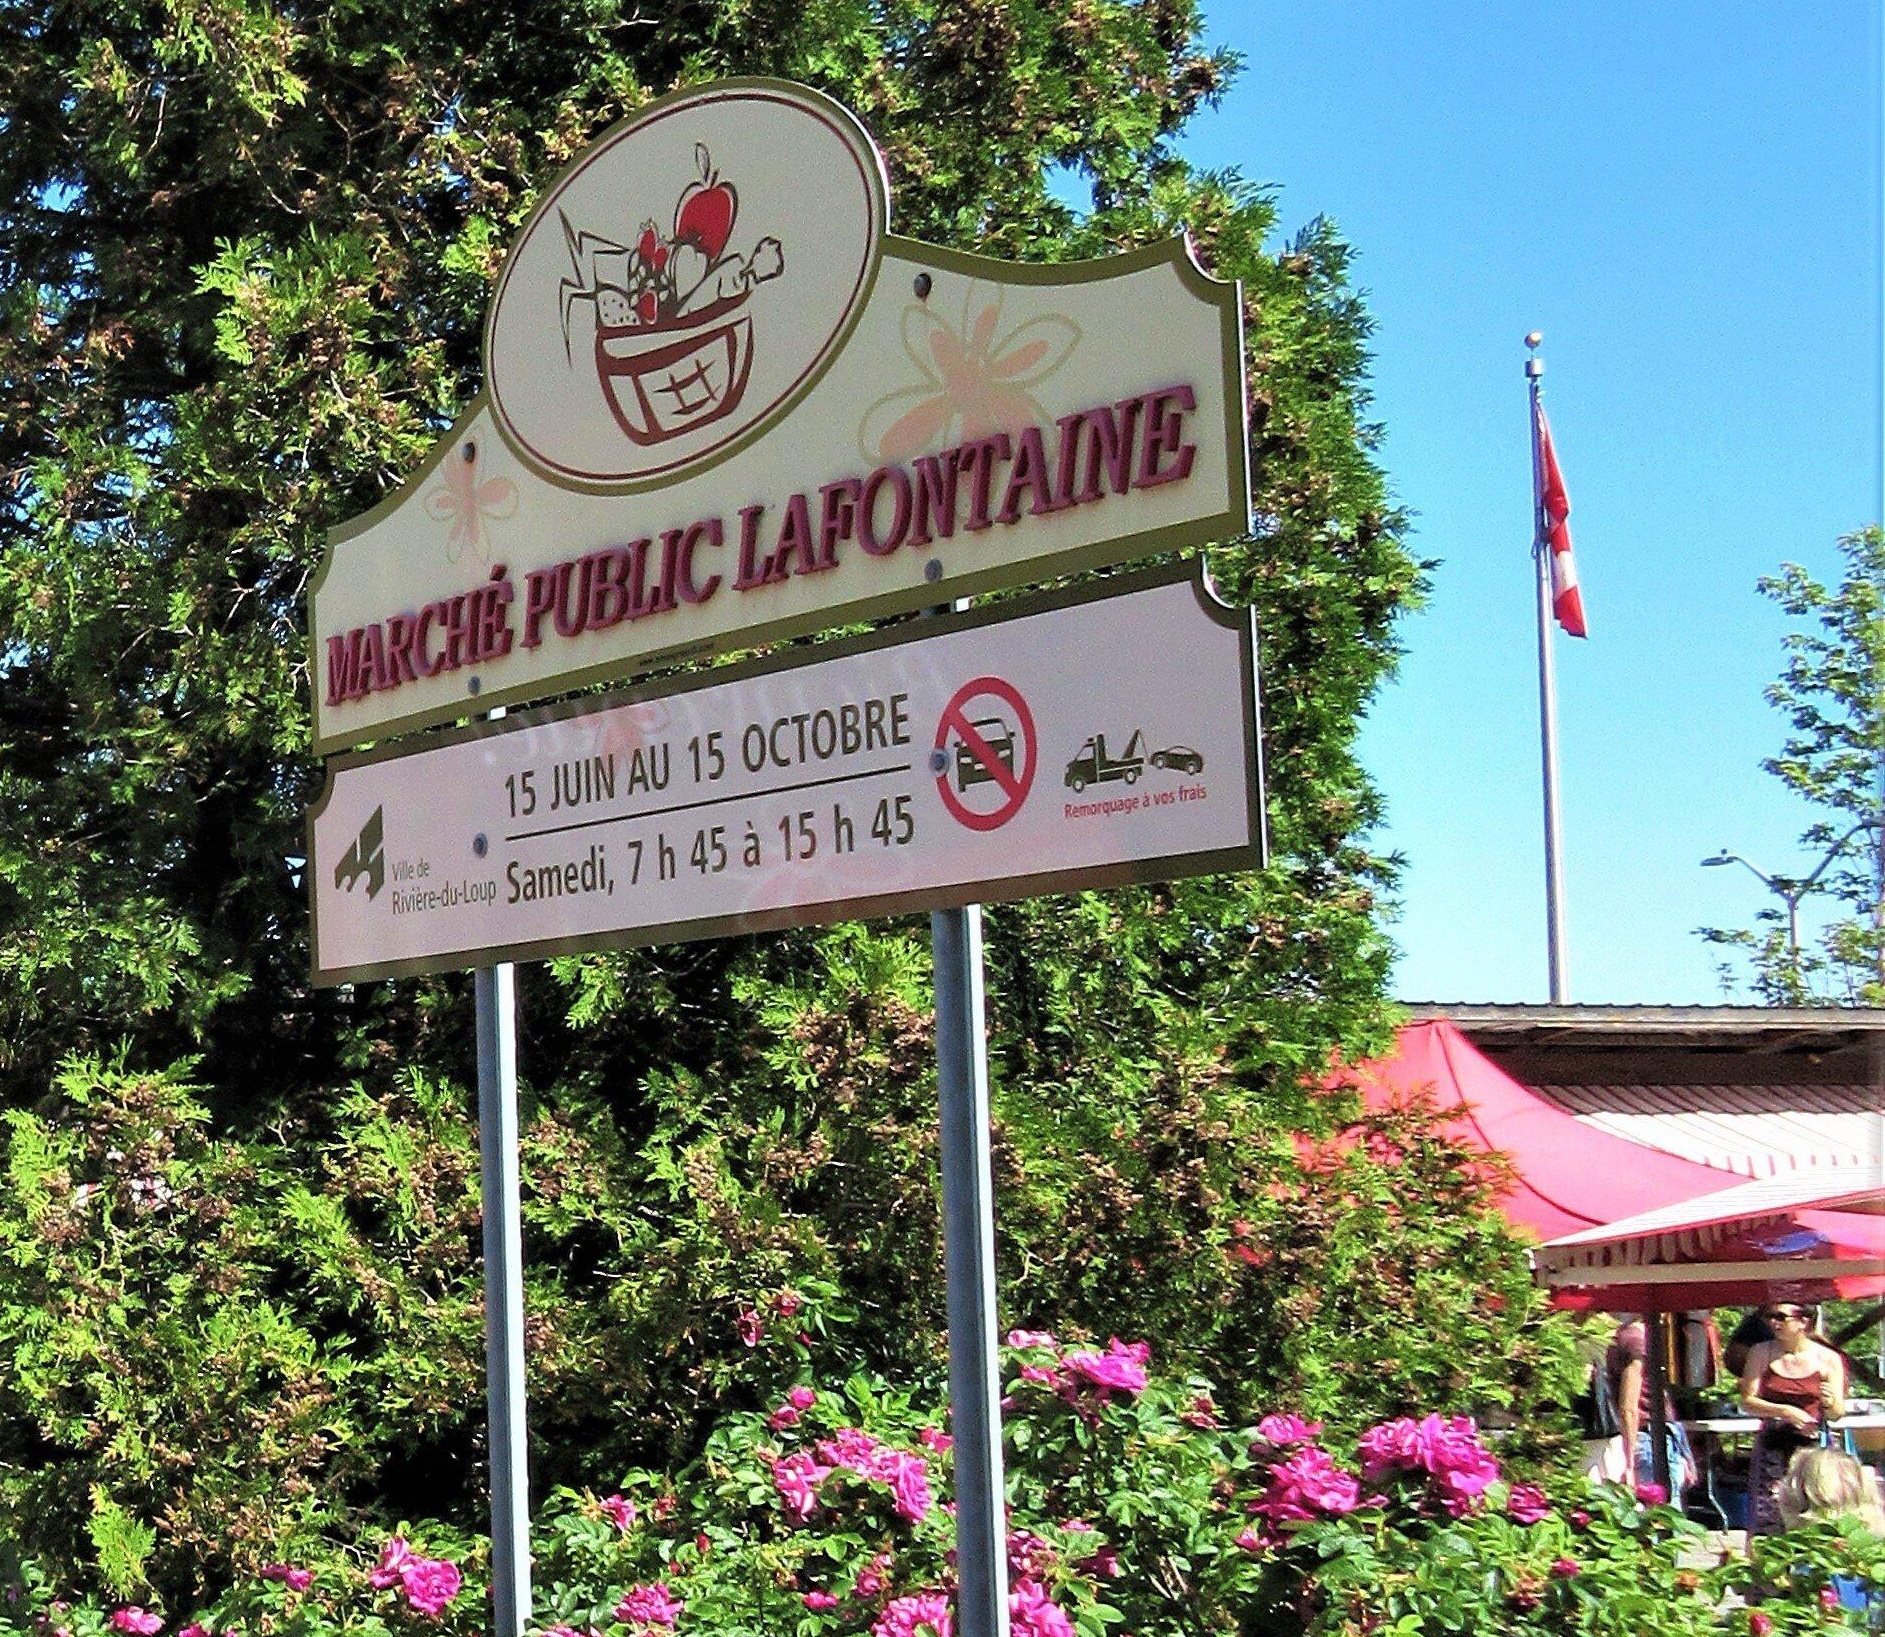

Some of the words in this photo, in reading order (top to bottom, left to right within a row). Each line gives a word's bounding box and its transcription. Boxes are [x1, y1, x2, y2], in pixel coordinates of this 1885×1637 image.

[324, 563, 515, 707] MARCHÉ
[519, 518, 724, 648] PUBLIC
[731, 383, 1198, 592] LAFONTAINE
[504, 768, 538, 818] 15
[549, 753, 615, 811] JUIN
[626, 743, 670, 796] AU
[687, 731, 725, 784] 15
[741, 693, 911, 774] OCTOBRE
[1063, 797, 1140, 820] Remorquage
[1142, 792, 1150, 808] à
[1153, 792, 1176, 806] vos
[1179, 783, 1208, 803] frais
[392, 861, 414, 881] Ville
[416, 857, 430, 878] de
[505, 844, 614, 904] Samedi,
[627, 839, 643, 885] 7
[657, 832, 676, 881] h
[690, 825, 727, 875] 45
[742, 820, 762, 867] à
[778, 811, 817, 862] 15
[833, 803, 854, 854] h
[870, 795, 915, 847] 45
[391, 879, 497, 915] Rivière-du-Loup
